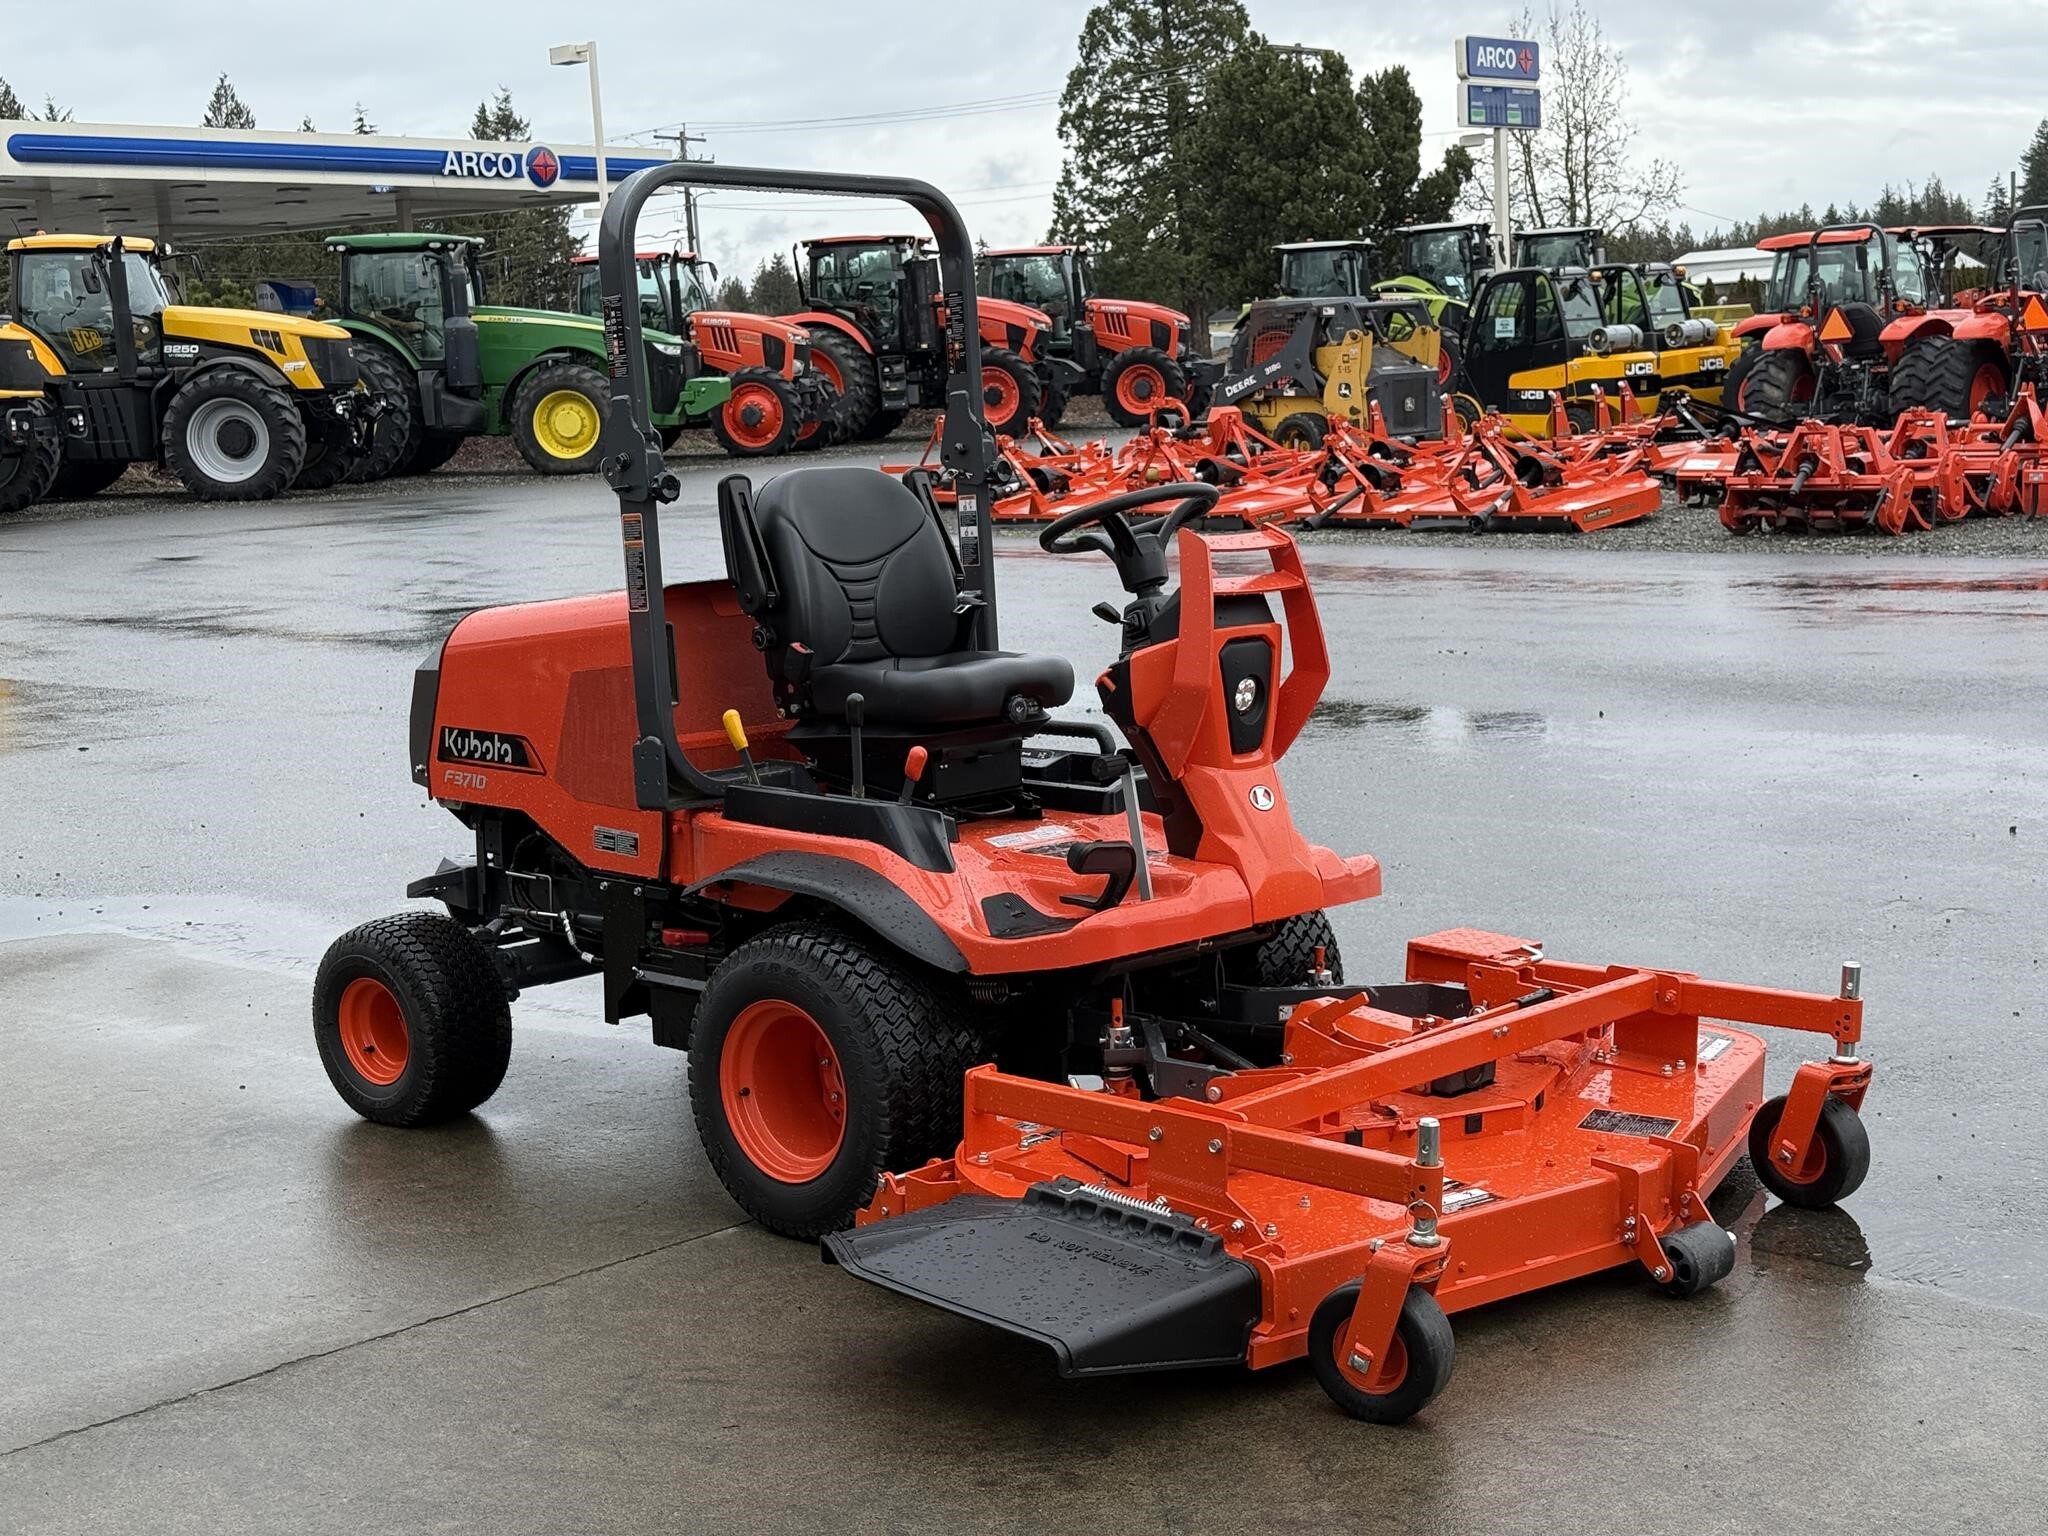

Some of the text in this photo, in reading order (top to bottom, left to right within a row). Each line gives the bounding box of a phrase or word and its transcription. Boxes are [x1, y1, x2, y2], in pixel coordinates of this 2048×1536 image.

[1476, 46, 1517, 70] ARCO
[442, 151, 517, 179] ARCO
[72, 329, 100, 352] JCB
[163, 344, 200, 354] 8250
[1625, 361, 1654, 376] JCB
[1700, 356, 1724, 371] JCB
[1225, 374, 1257, 398] DEERE
[1520, 390, 1545, 400] JCB
[444, 727, 513, 764] Kubota
[444, 769, 488, 790] F3710
